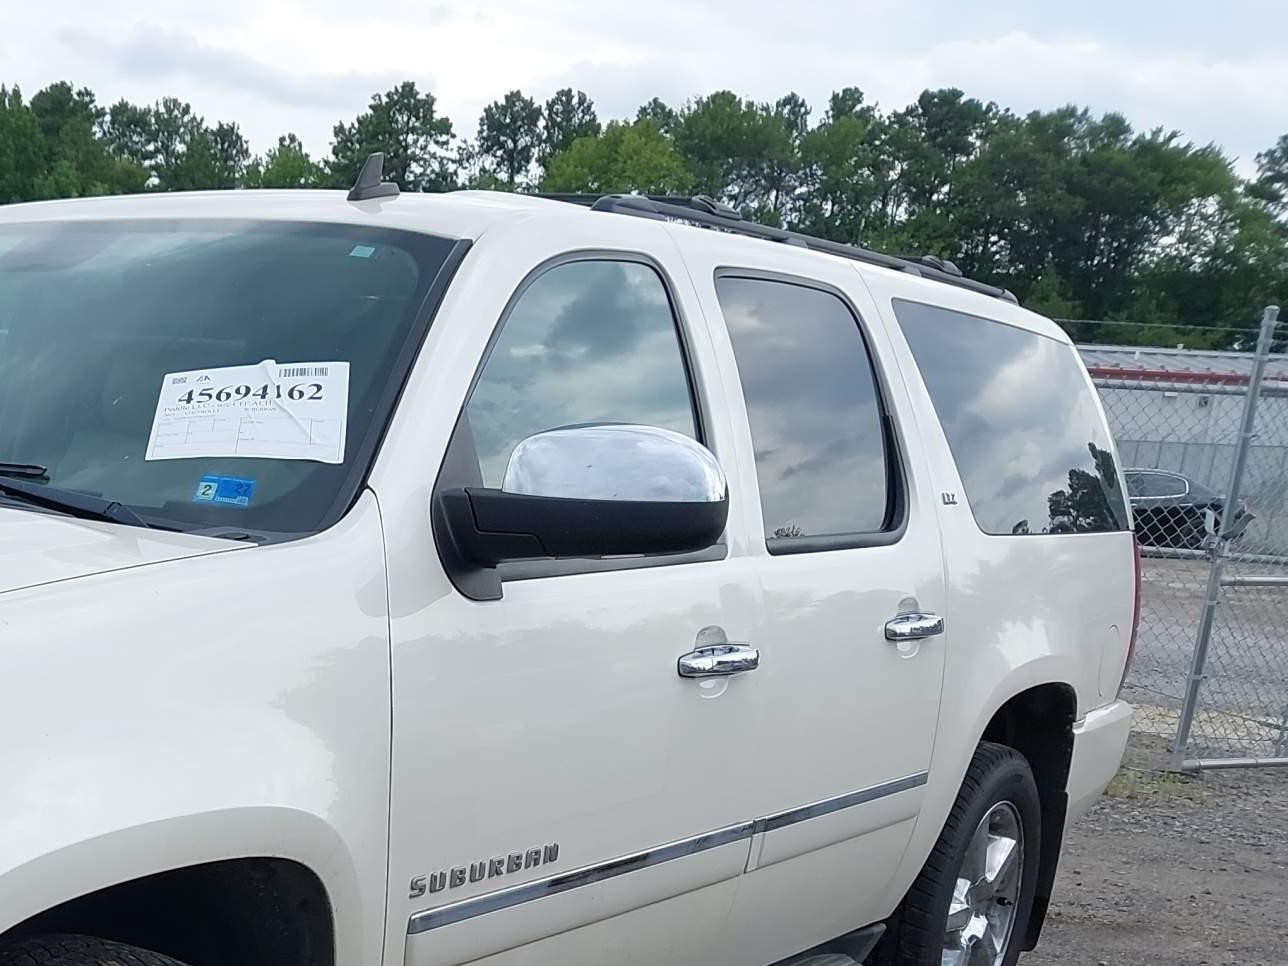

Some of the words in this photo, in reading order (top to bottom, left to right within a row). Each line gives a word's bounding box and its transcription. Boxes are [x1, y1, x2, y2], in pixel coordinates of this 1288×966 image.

[178, 383, 324, 405] 45694162
[200, 484, 213, 496] 2
[408, 842, 560, 899] SUBURBAN
